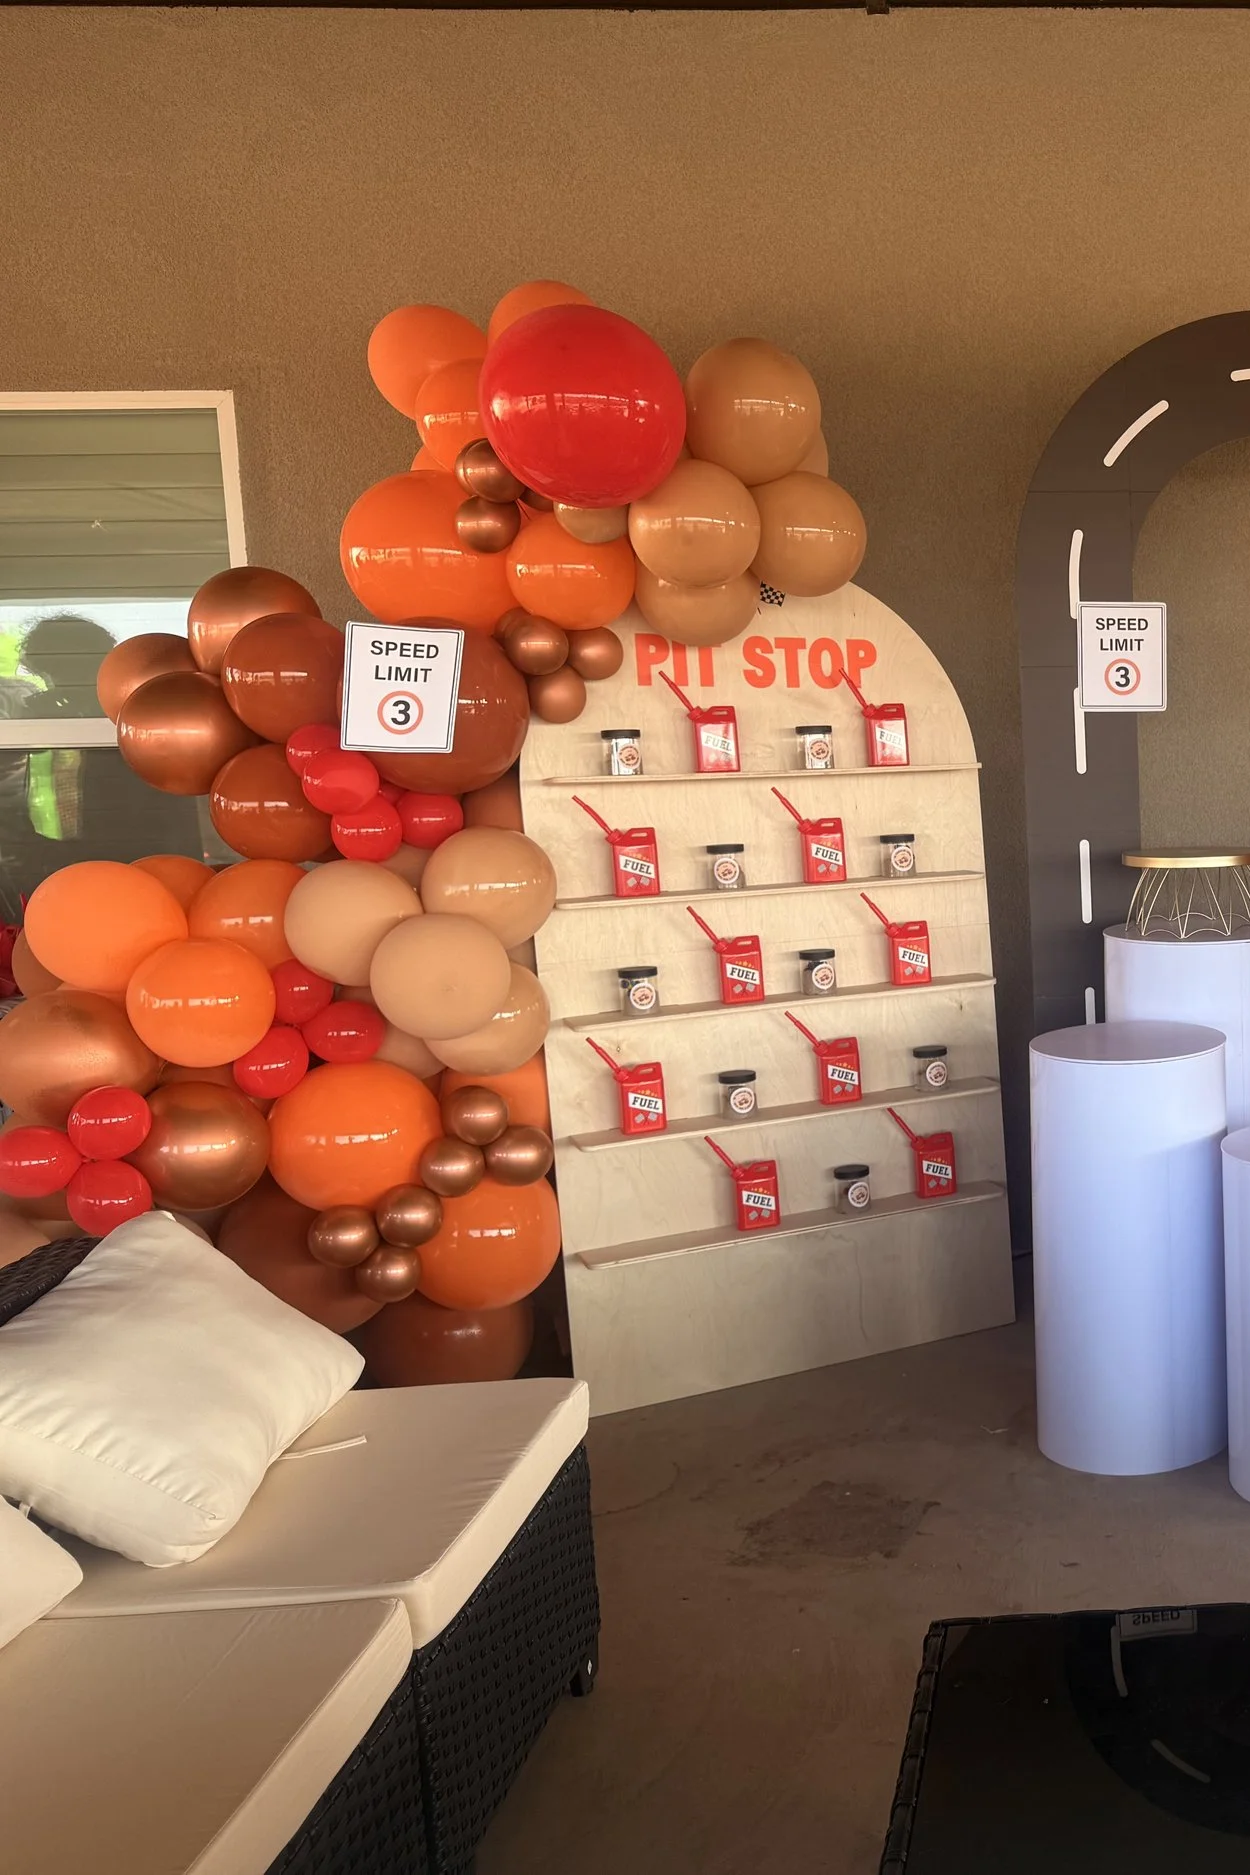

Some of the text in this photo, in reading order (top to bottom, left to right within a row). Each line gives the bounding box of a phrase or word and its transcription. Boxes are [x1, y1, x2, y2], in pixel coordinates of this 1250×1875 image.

[1095, 617, 1149, 631] SPEED
[370, 640, 439, 659] SPEED
[1099, 638, 1145, 651] LIMIT
[634, 633, 877, 690] PIT STOP
[374, 665, 433, 683] LIMIT
[1115, 666, 1131, 688] 3
[390, 700, 412, 726] 3
[704, 735, 732, 751] FUEL
[880, 730, 903, 746] FUEL
[815, 846, 841, 862] FUEL
[623, 858, 653, 875] FUEL
[902, 949, 926, 964] FUEL
[729, 966, 757, 981] FUEL
[831, 1068, 856, 1082] FUEL
[631, 1095, 660, 1111] FUEL
[926, 1163, 950, 1177] FUEL
[745, 1193, 773, 1208] FUEL
